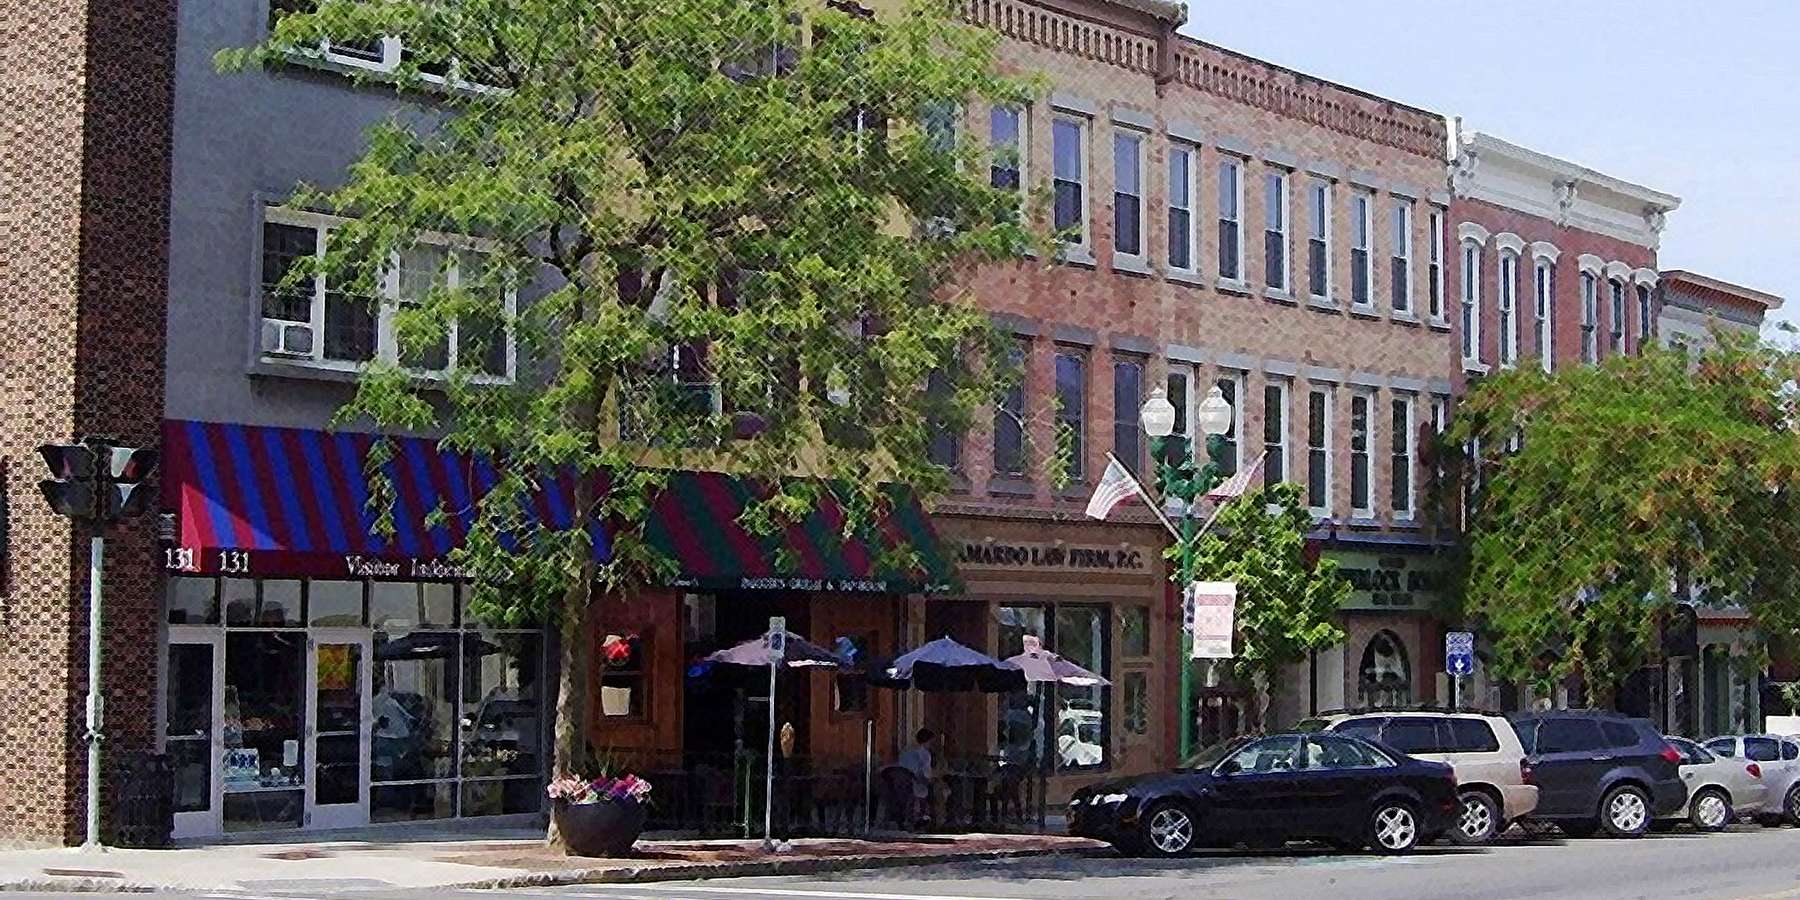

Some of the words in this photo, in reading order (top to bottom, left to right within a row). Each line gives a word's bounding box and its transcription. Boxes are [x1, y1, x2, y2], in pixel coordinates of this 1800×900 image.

[165, 548, 194, 569] 131
[218, 551, 249, 573] 131
[345, 555, 400, 577] Visitor
